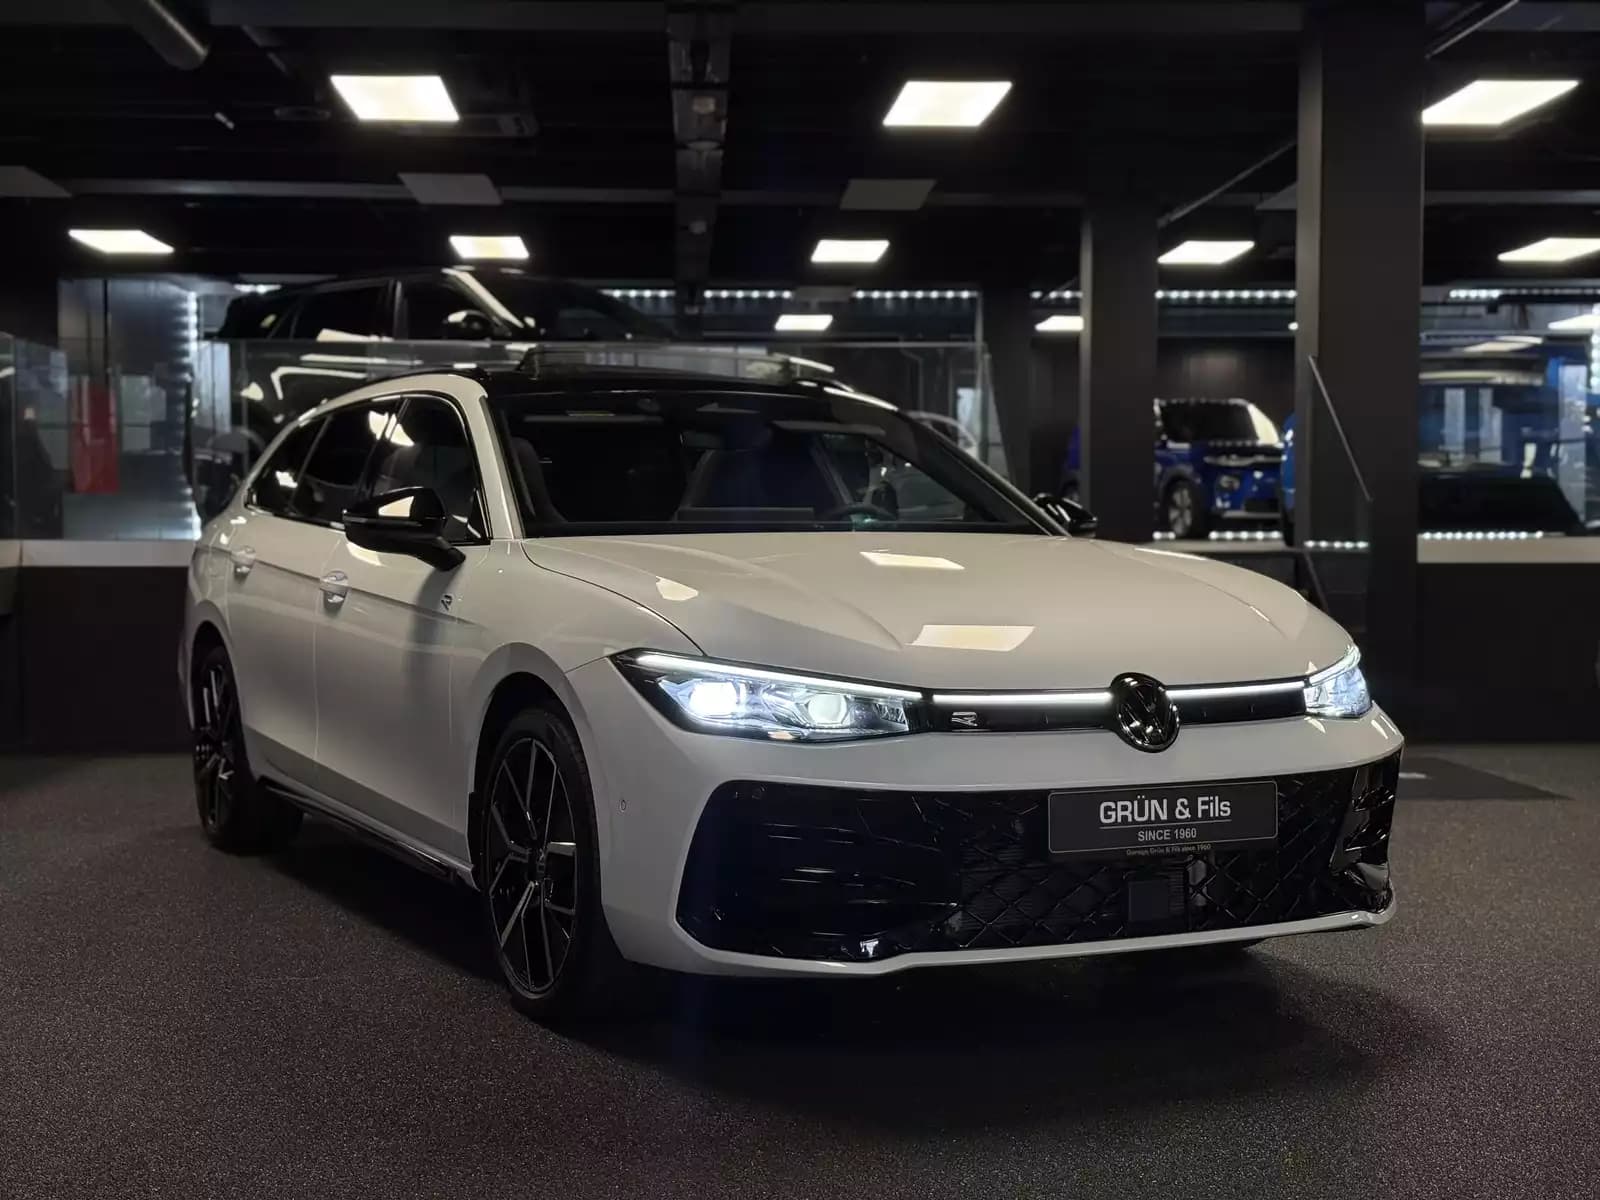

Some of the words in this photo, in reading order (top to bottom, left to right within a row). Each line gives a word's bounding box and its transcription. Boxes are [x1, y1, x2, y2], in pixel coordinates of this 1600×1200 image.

[1100, 795, 1168, 823] GRÜN
[1175, 798, 1191, 819] &
[1197, 796, 1231, 818] Fils
[1137, 829, 1171, 841] SINCE
[1174, 827, 1197, 839] 1960
